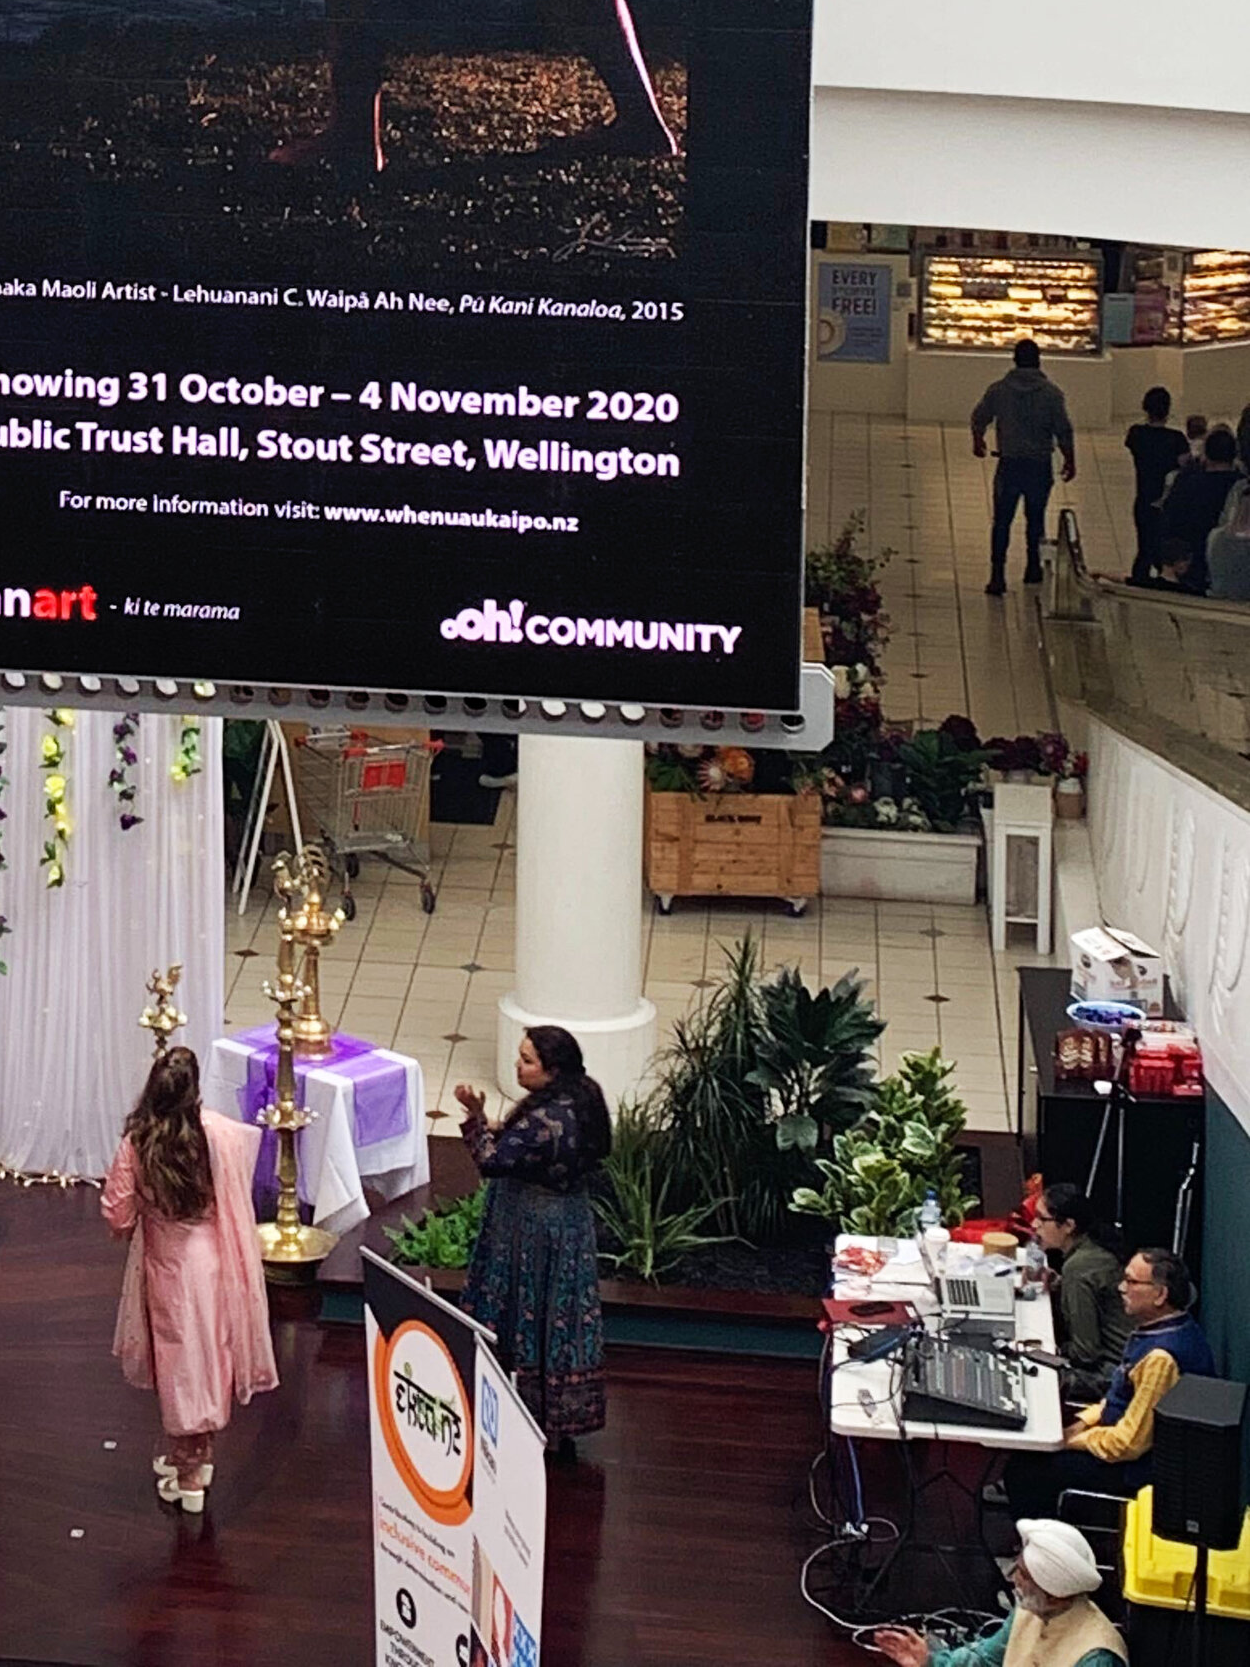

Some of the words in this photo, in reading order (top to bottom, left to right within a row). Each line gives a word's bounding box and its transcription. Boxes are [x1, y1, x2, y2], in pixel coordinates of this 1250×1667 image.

[831, 269, 878, 286] EVERY
[42, 279, 96, 299] Maoli
[102, 282, 156, 301] Artist
[174, 285, 278, 305] Lehuanani
[283, 288, 303, 306] C.
[374, 291, 403, 310] Ah
[409, 293, 454, 314] Nee,
[489, 296, 534, 315] Kani
[538, 298, 625, 320] Kanaloa,
[632, 301, 683, 320] 2015
[831, 296, 877, 315] FREE!
[128, 372, 166, 401] 31
[180, 374, 324, 407] October
[359, 382, 382, 409] 4
[391, 382, 580, 418] November
[586, 390, 679, 422] 2020
[75, 422, 163, 454] Trust
[172, 425, 248, 461] Hall,
[257, 430, 353, 462] Stout
[360, 434, 476, 471] Street,
[484, 439, 679, 480] Wellington
[60, 491, 92, 509] For
[96, 496, 147, 511] more
[153, 494, 268, 516] information
[274, 501, 320, 519] visit:
[324, 505, 578, 534] www.whenuaukaipo.nz
[124, 597, 140, 615] ki
[144, 601, 160, 615] te
[163, 604, 240, 619] marama
